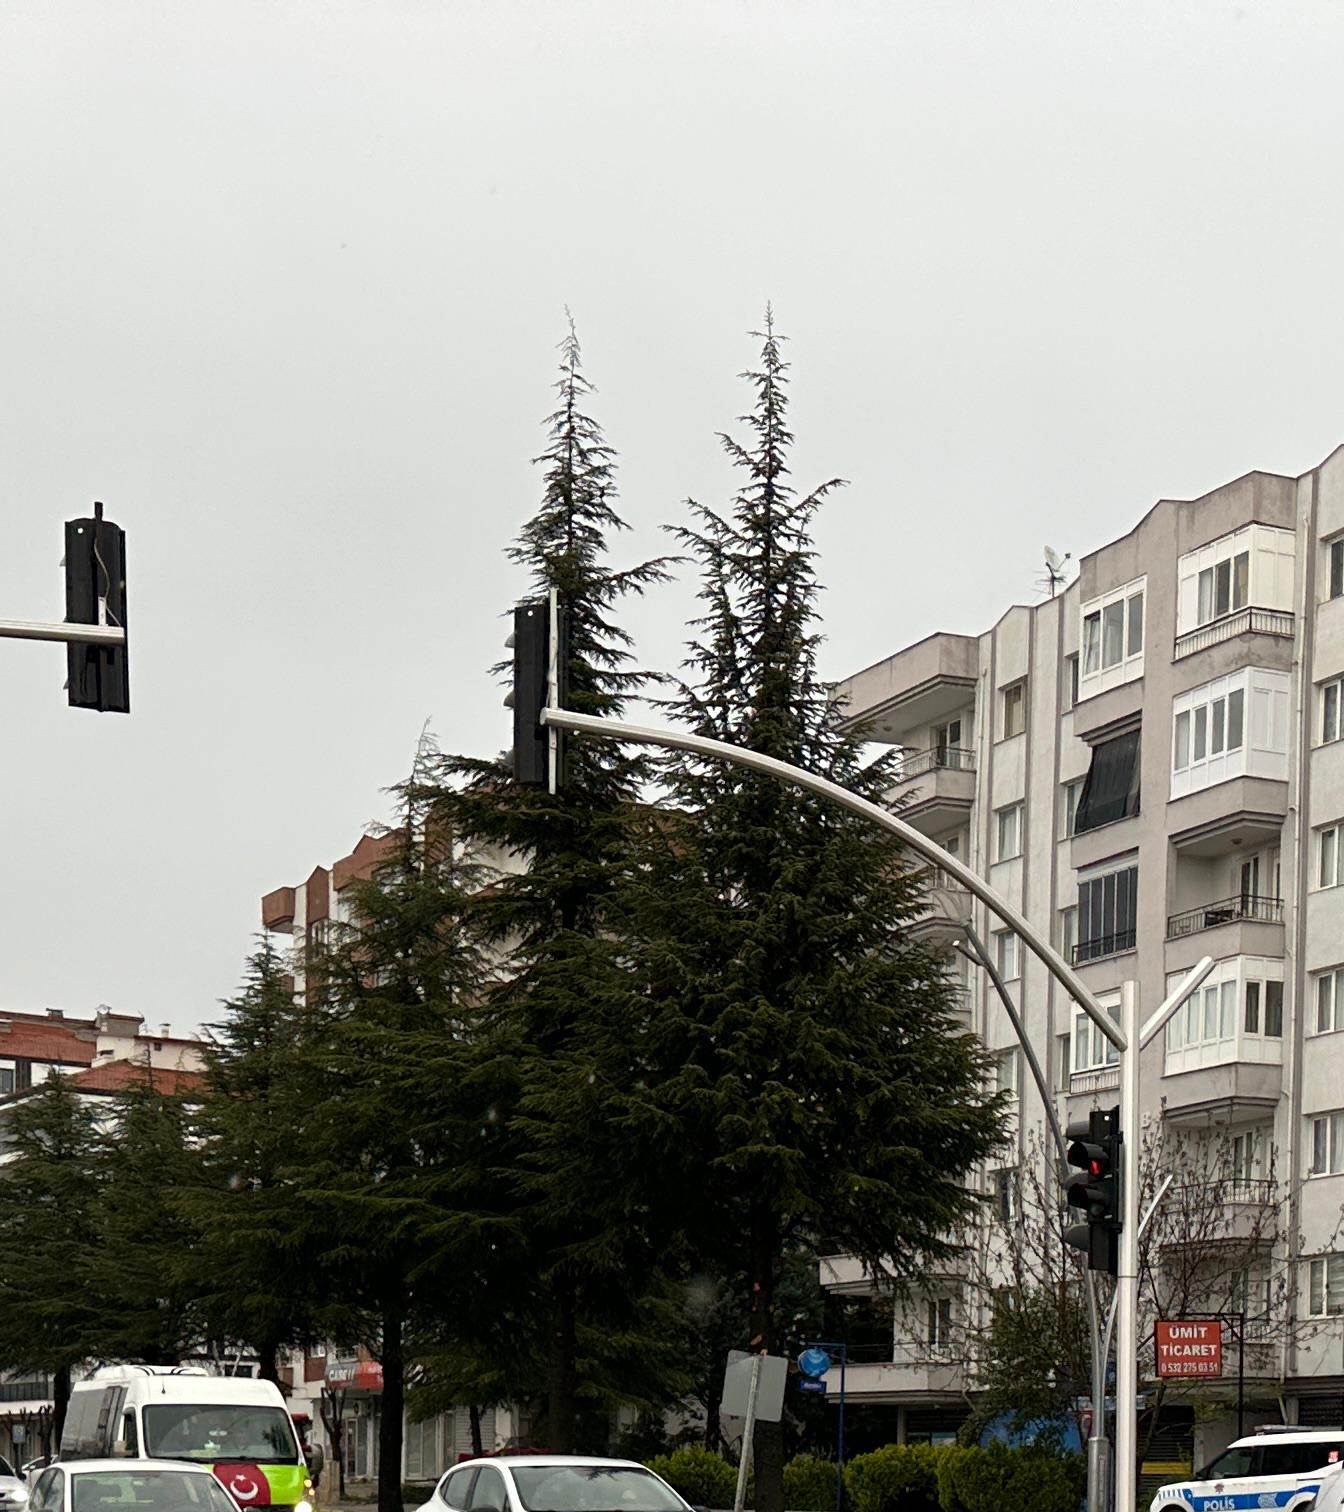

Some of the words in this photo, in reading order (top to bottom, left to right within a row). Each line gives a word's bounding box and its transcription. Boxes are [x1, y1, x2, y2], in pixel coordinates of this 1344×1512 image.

[1169, 1324, 1208, 1339] ÜMİT
[1160, 1342, 1218, 1357] TİCARET
[1204, 1496, 1235, 1511] POLİS
